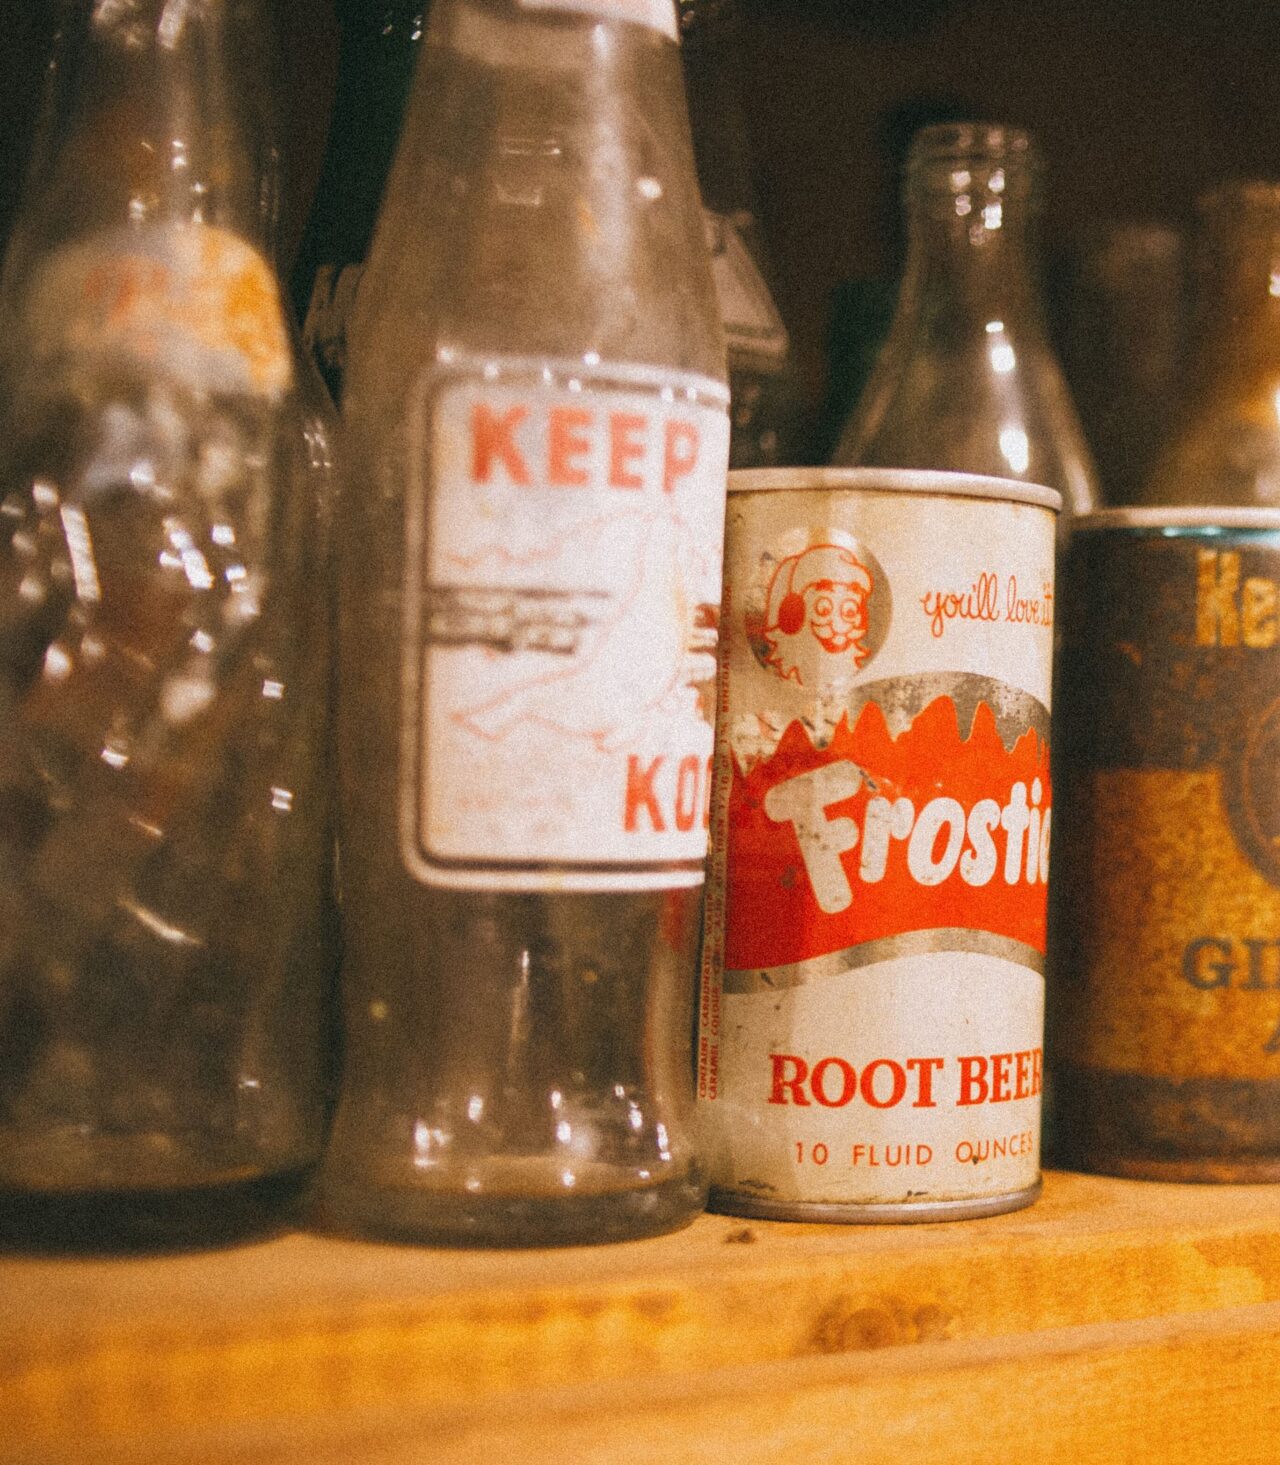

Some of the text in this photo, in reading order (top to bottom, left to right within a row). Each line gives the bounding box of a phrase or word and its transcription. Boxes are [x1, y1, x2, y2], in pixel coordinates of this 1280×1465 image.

[469, 403, 701, 493] KEEP
[920, 571, 1000, 638] you'll
[1005, 575, 1040, 625] love
[707, 1044, 718, 1102] CARAMEL
[768, 1047, 1042, 1109] ROOT BEER
[796, 1130, 1034, 1167] 10 FLUID OUNCES
